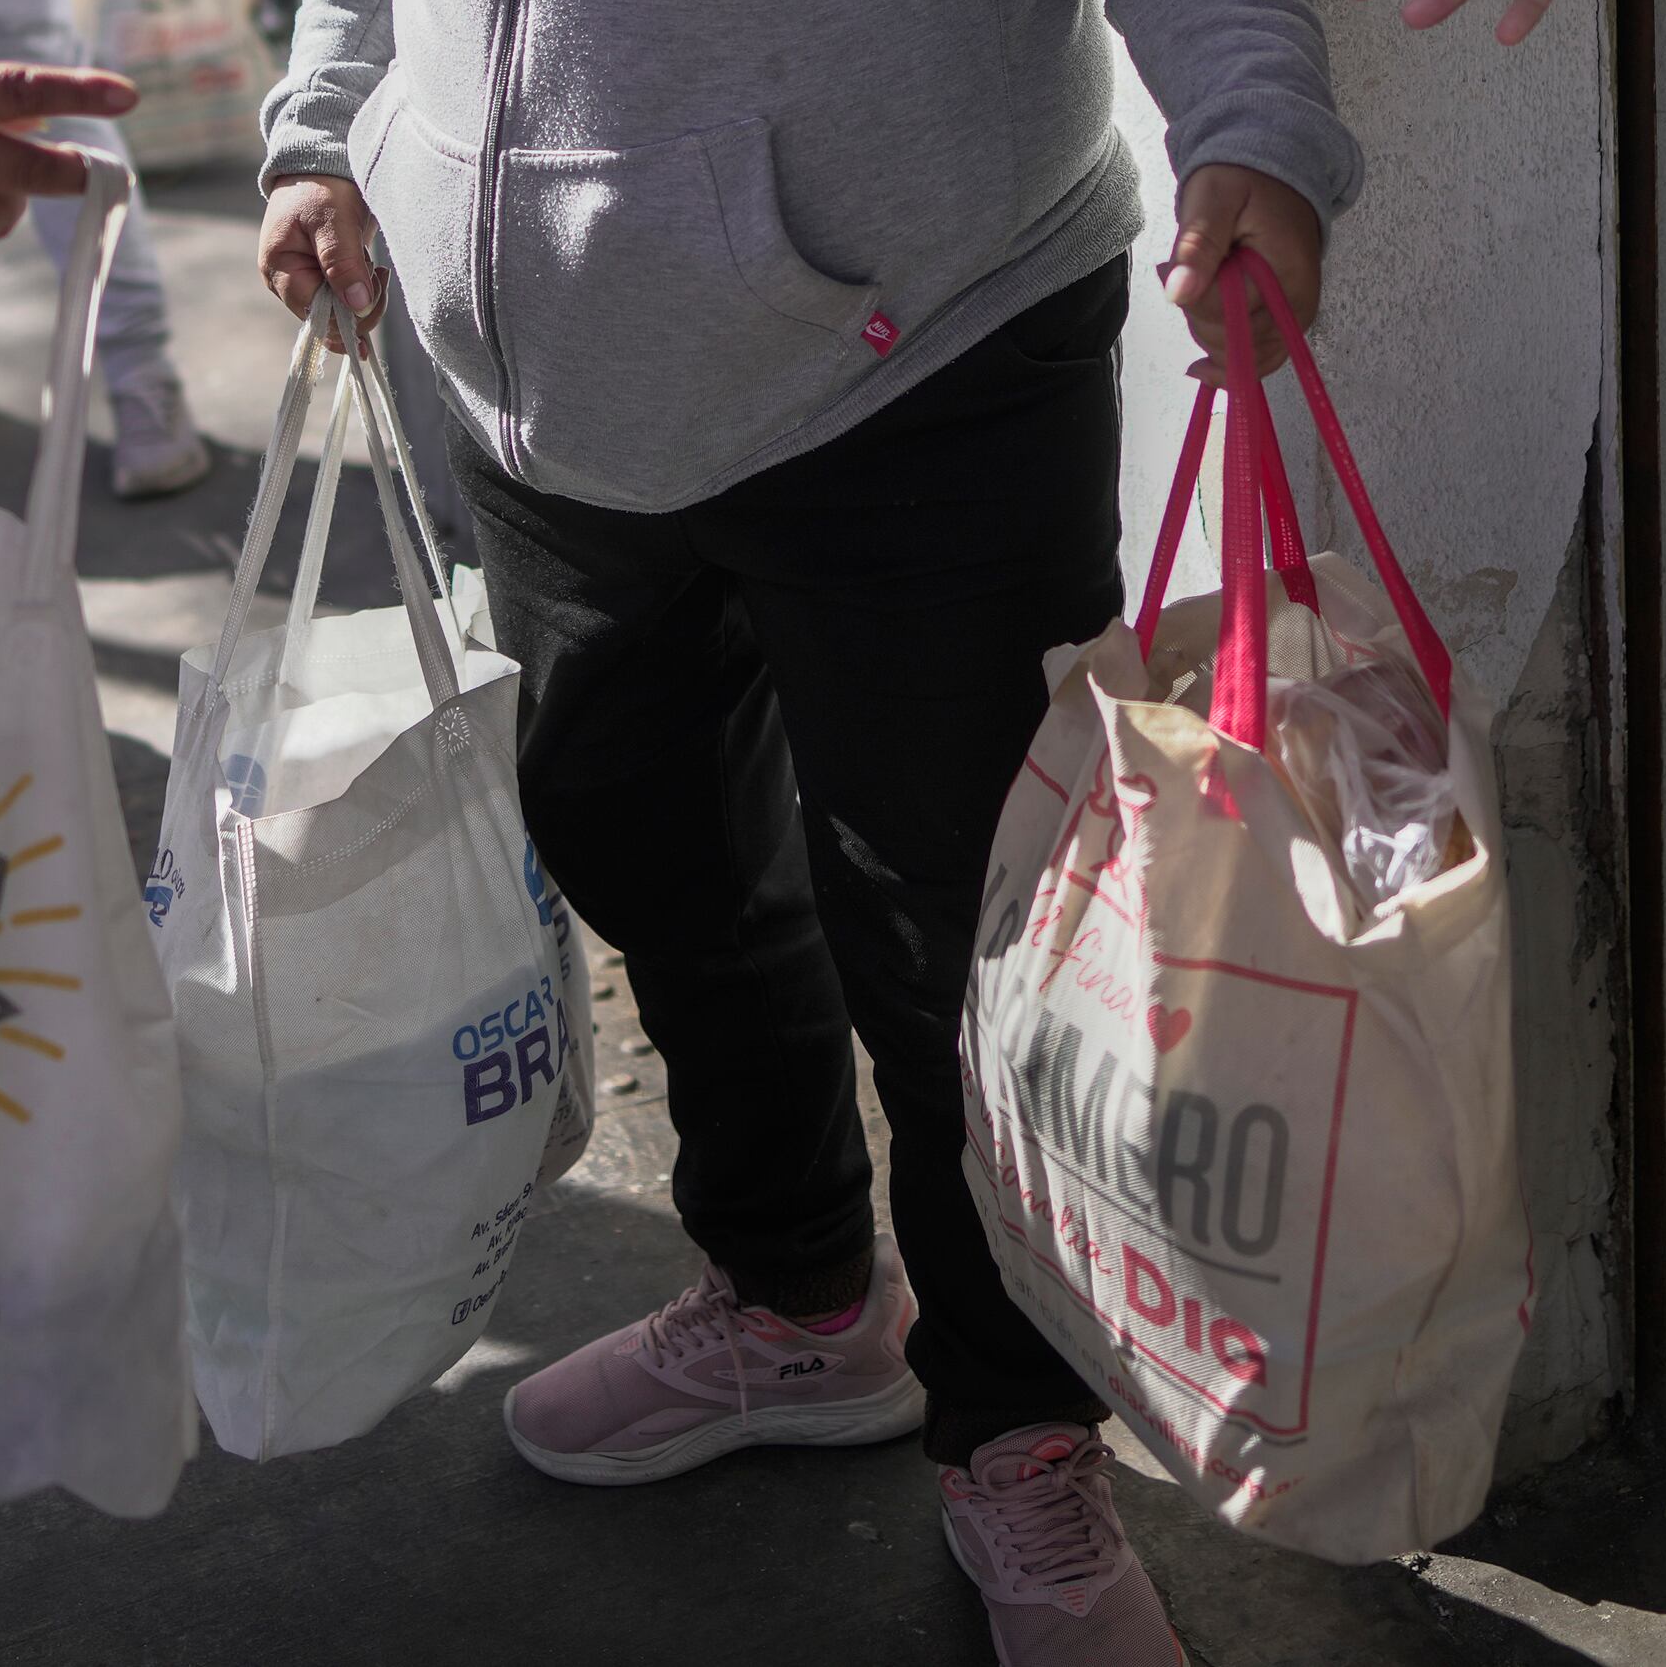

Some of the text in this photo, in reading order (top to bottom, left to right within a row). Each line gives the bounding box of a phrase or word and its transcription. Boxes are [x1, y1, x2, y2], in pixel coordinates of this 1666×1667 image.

[872, 320, 890, 337] NIKE
[452, 975, 555, 1061] OSCAR
[780, 1357, 825, 1380] FILA
